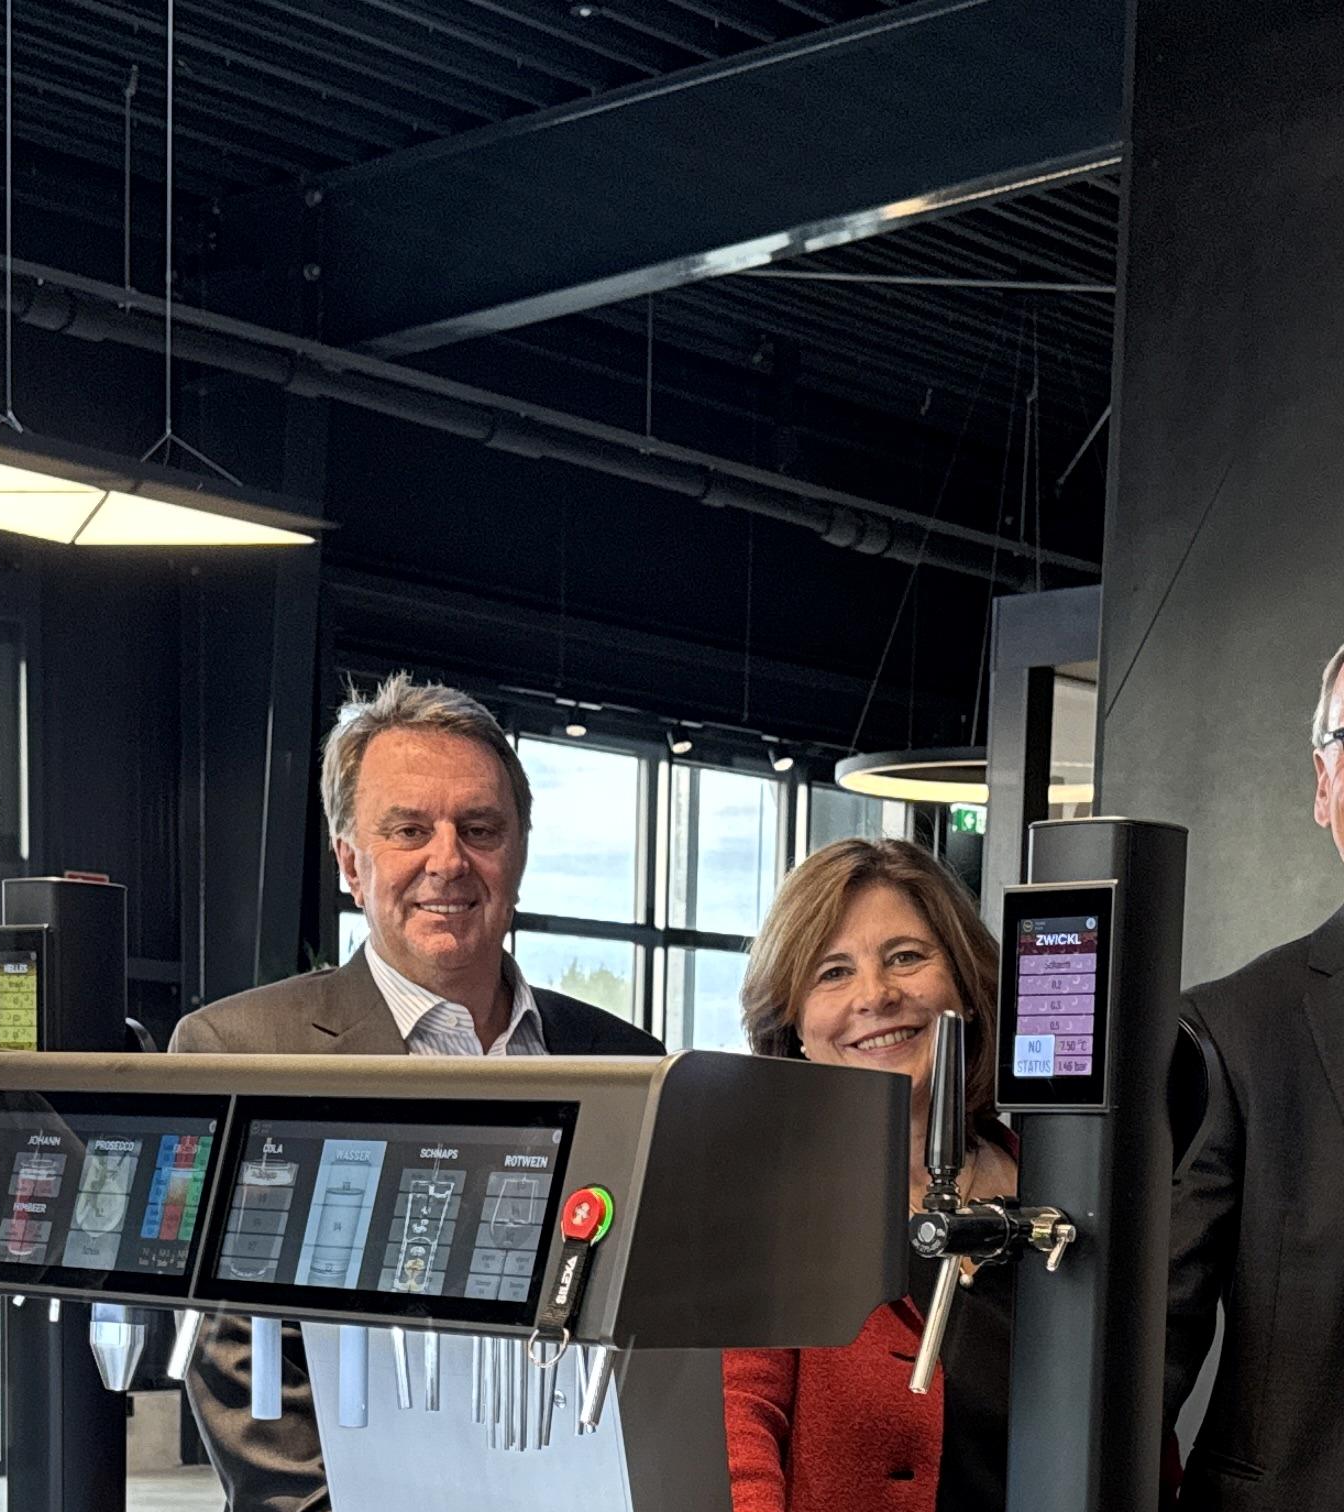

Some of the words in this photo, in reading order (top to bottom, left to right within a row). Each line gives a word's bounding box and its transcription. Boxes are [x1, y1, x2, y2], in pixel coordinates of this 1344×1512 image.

[1035, 933, 1082, 946] ZWICKL
[1028, 1040, 1042, 1053] NO
[1017, 1060, 1051, 1073] STATUS
[27, 1135, 61, 1146] JOHANN
[94, 1140, 135, 1152] PROSECCO
[262, 1143, 284, 1154] COLA
[419, 1147, 459, 1160] SCHNAPS
[335, 1150, 372, 1161] WASSER
[504, 1155, 549, 1169] ROTWEIN
